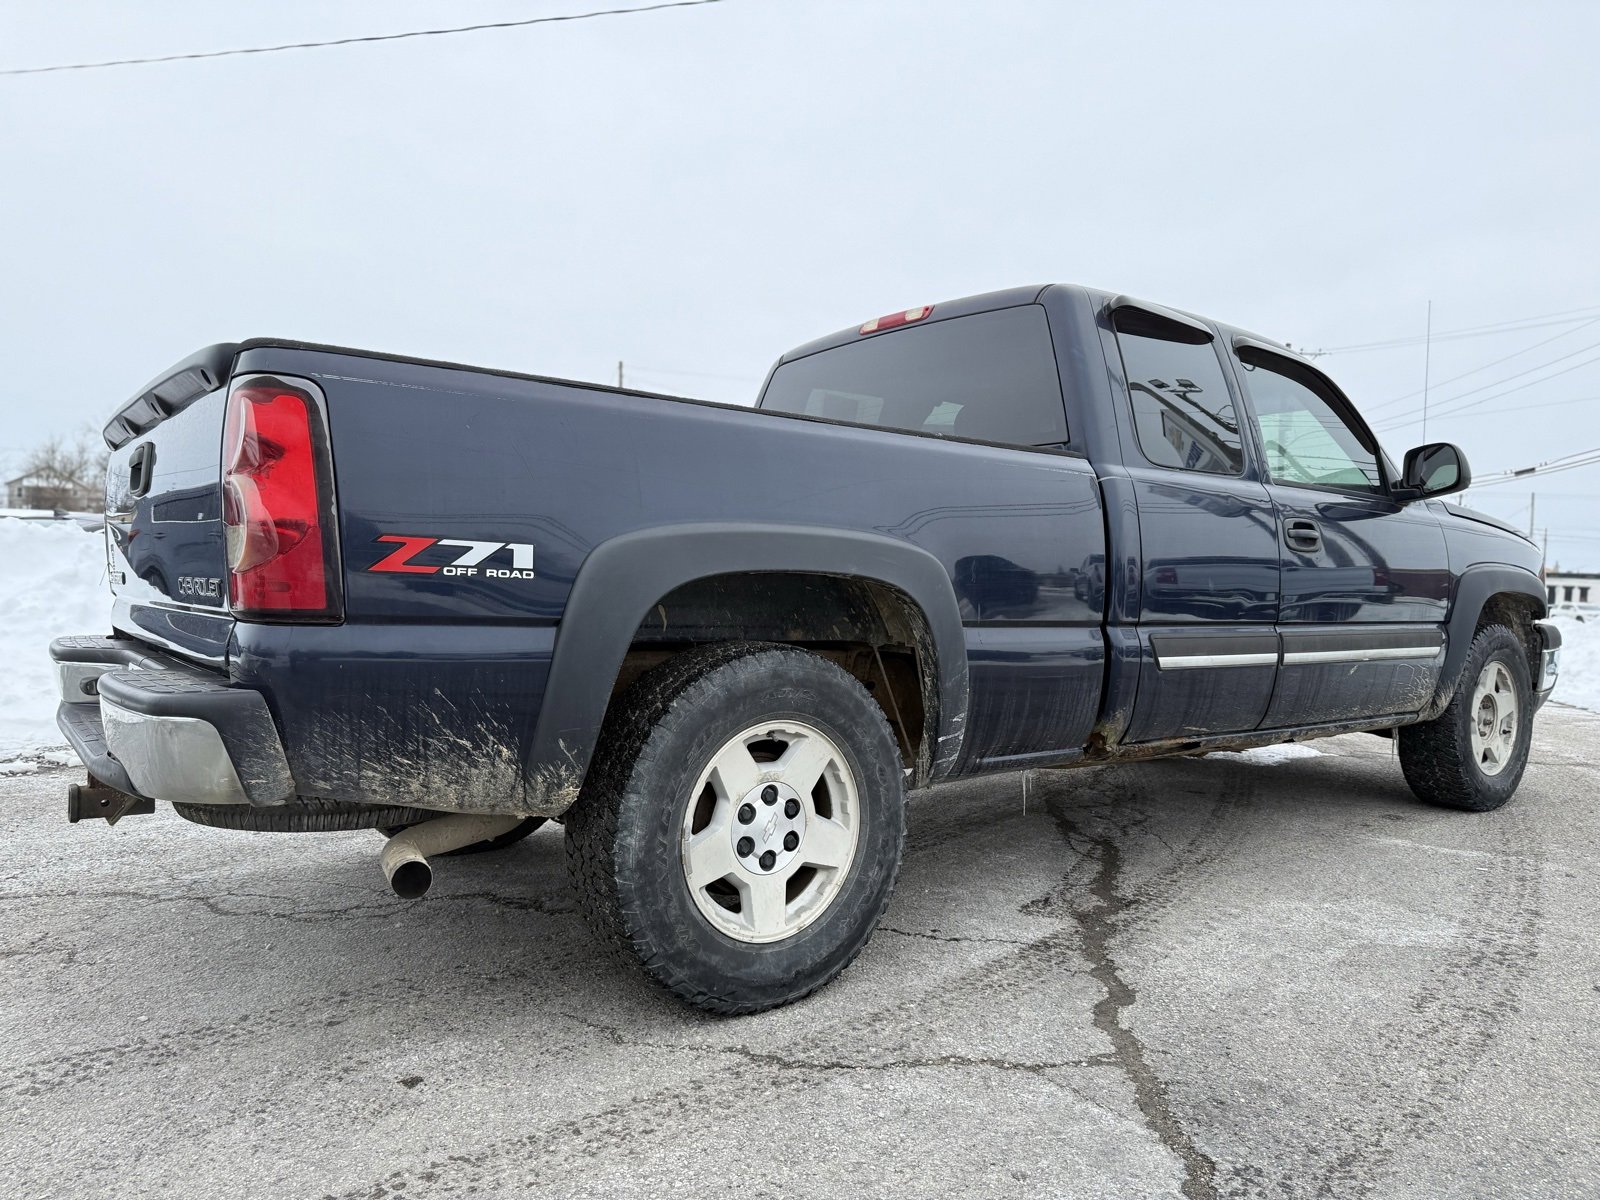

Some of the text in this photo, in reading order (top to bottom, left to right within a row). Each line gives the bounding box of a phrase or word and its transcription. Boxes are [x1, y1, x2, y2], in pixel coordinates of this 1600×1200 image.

[368, 535, 534, 574] Z71
[442, 566, 535, 579] OFF ROAD
[178, 576, 222, 597] CHEVROLET
